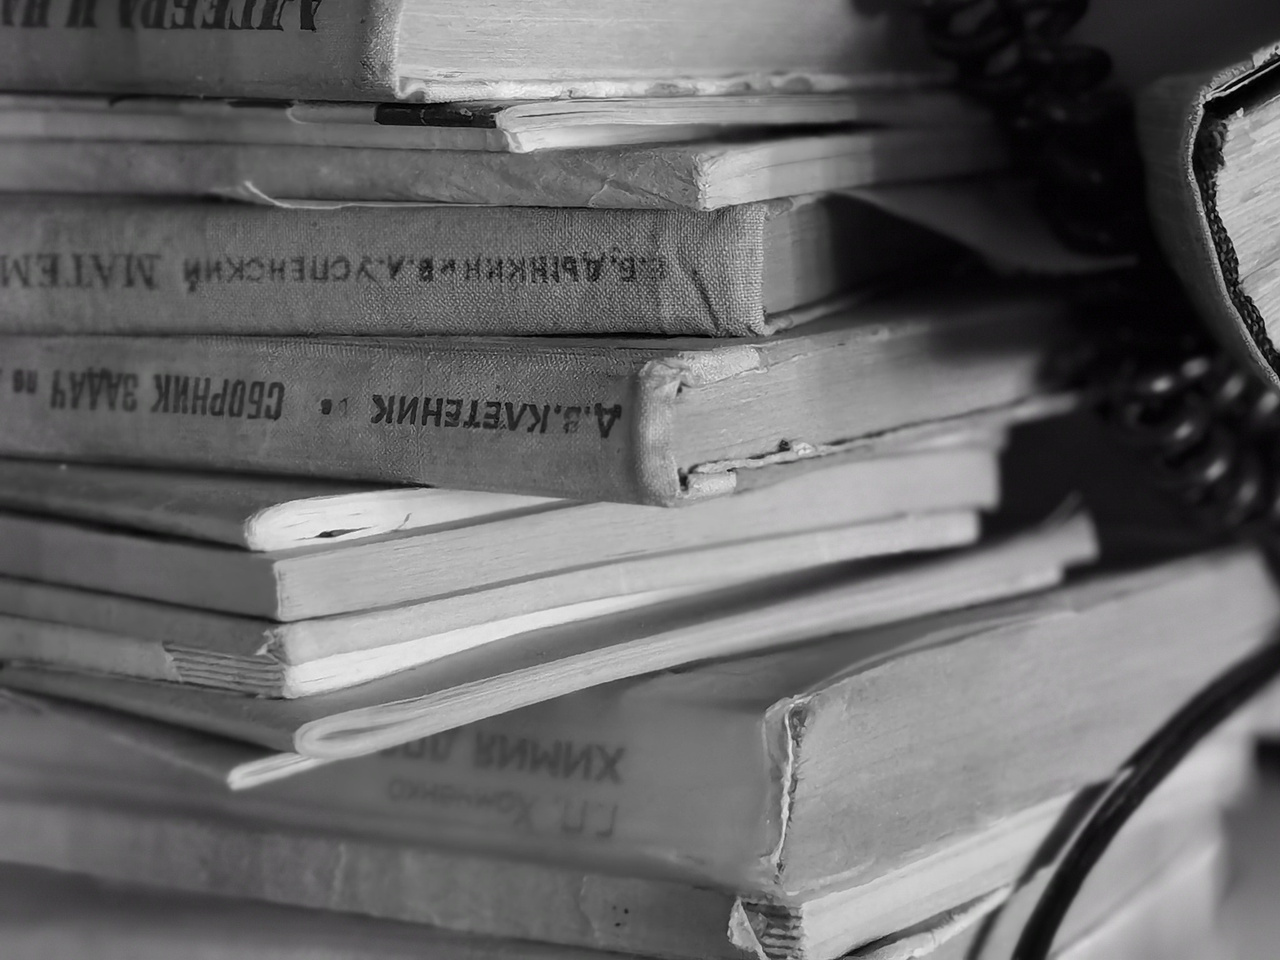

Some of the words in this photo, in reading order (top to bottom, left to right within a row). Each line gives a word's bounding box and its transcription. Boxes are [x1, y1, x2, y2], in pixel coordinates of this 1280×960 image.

[48, 367, 140, 413] ЗАДАЧ
[149, 373, 286, 422] СБОРНИК
[472, 731, 627, 785] ХИМИЯ
